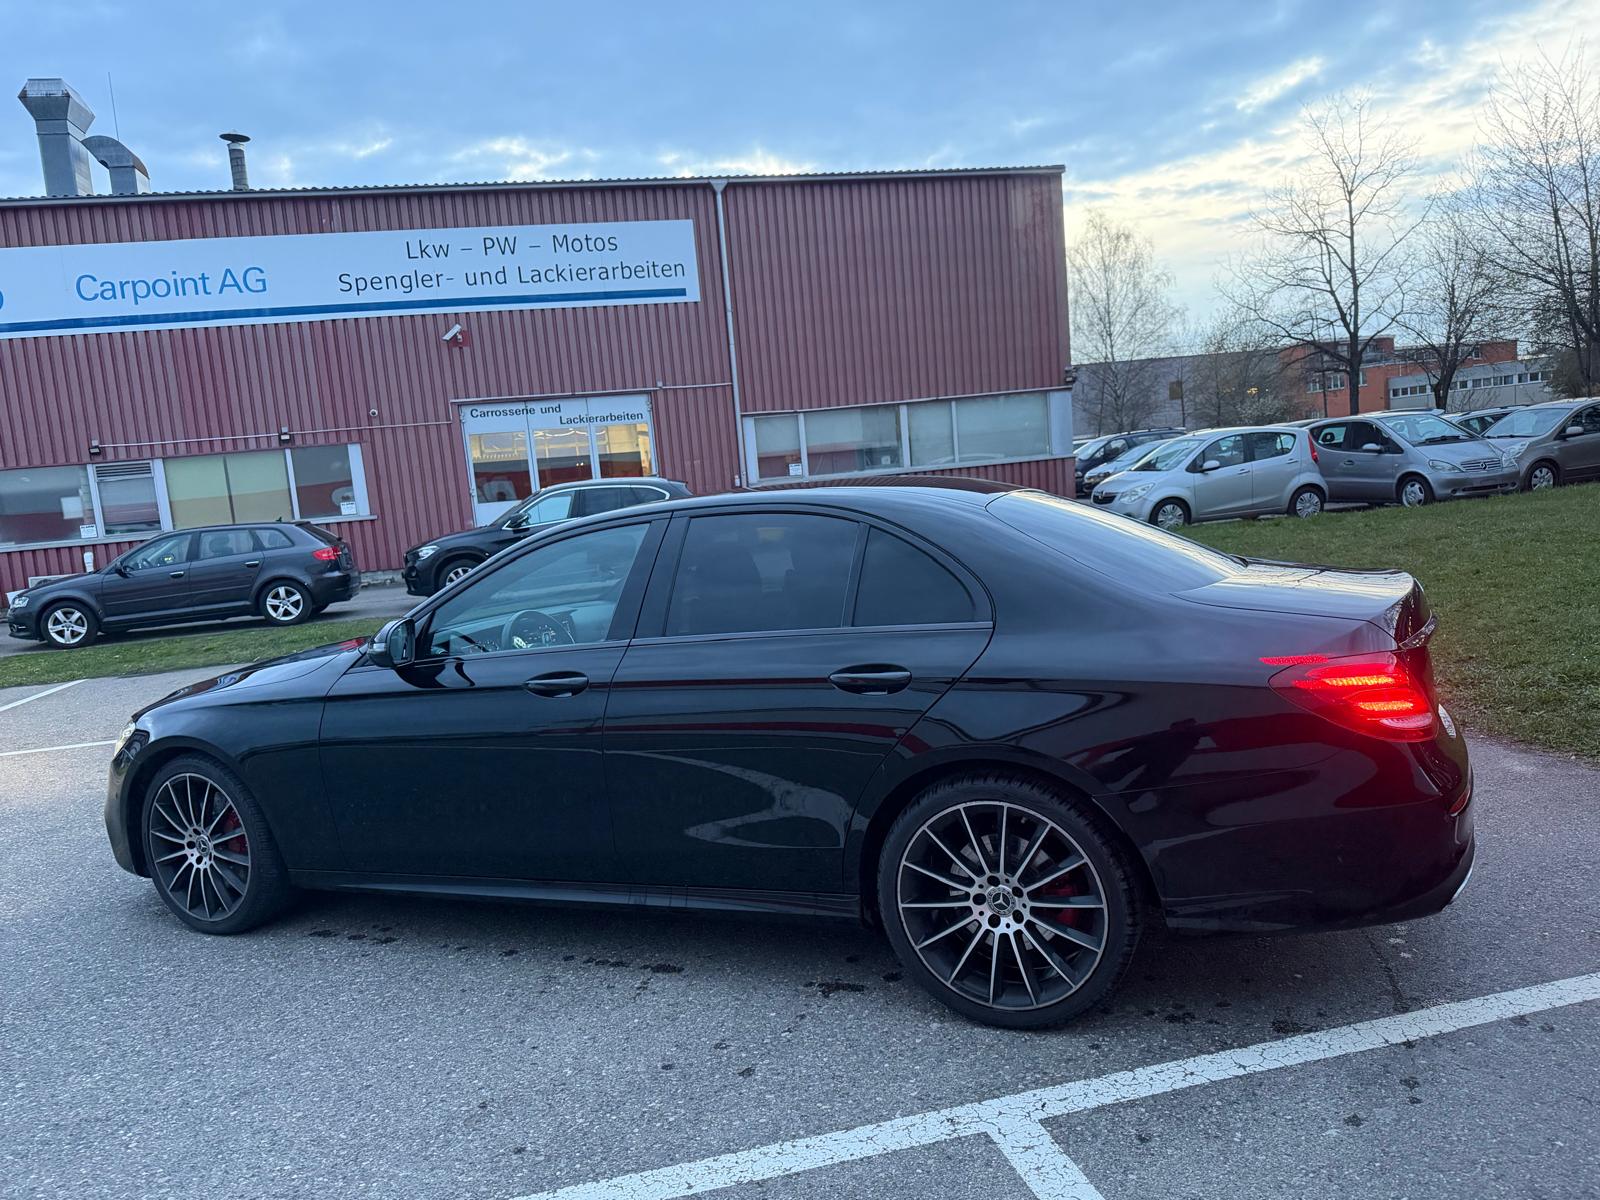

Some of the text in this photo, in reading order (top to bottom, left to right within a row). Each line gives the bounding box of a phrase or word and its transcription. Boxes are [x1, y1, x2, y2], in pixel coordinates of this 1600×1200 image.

[406, 239, 450, 260] Lkw
[482, 236, 517, 256] PW
[552, 234, 618, 254] Motos
[75, 266, 267, 305] Carpoint AG
[338, 260, 686, 296] Spengler- und Lackierarbeiten
[470, 403, 562, 419] Carrosserie und
[559, 411, 644, 425] Lackierarbeiten
